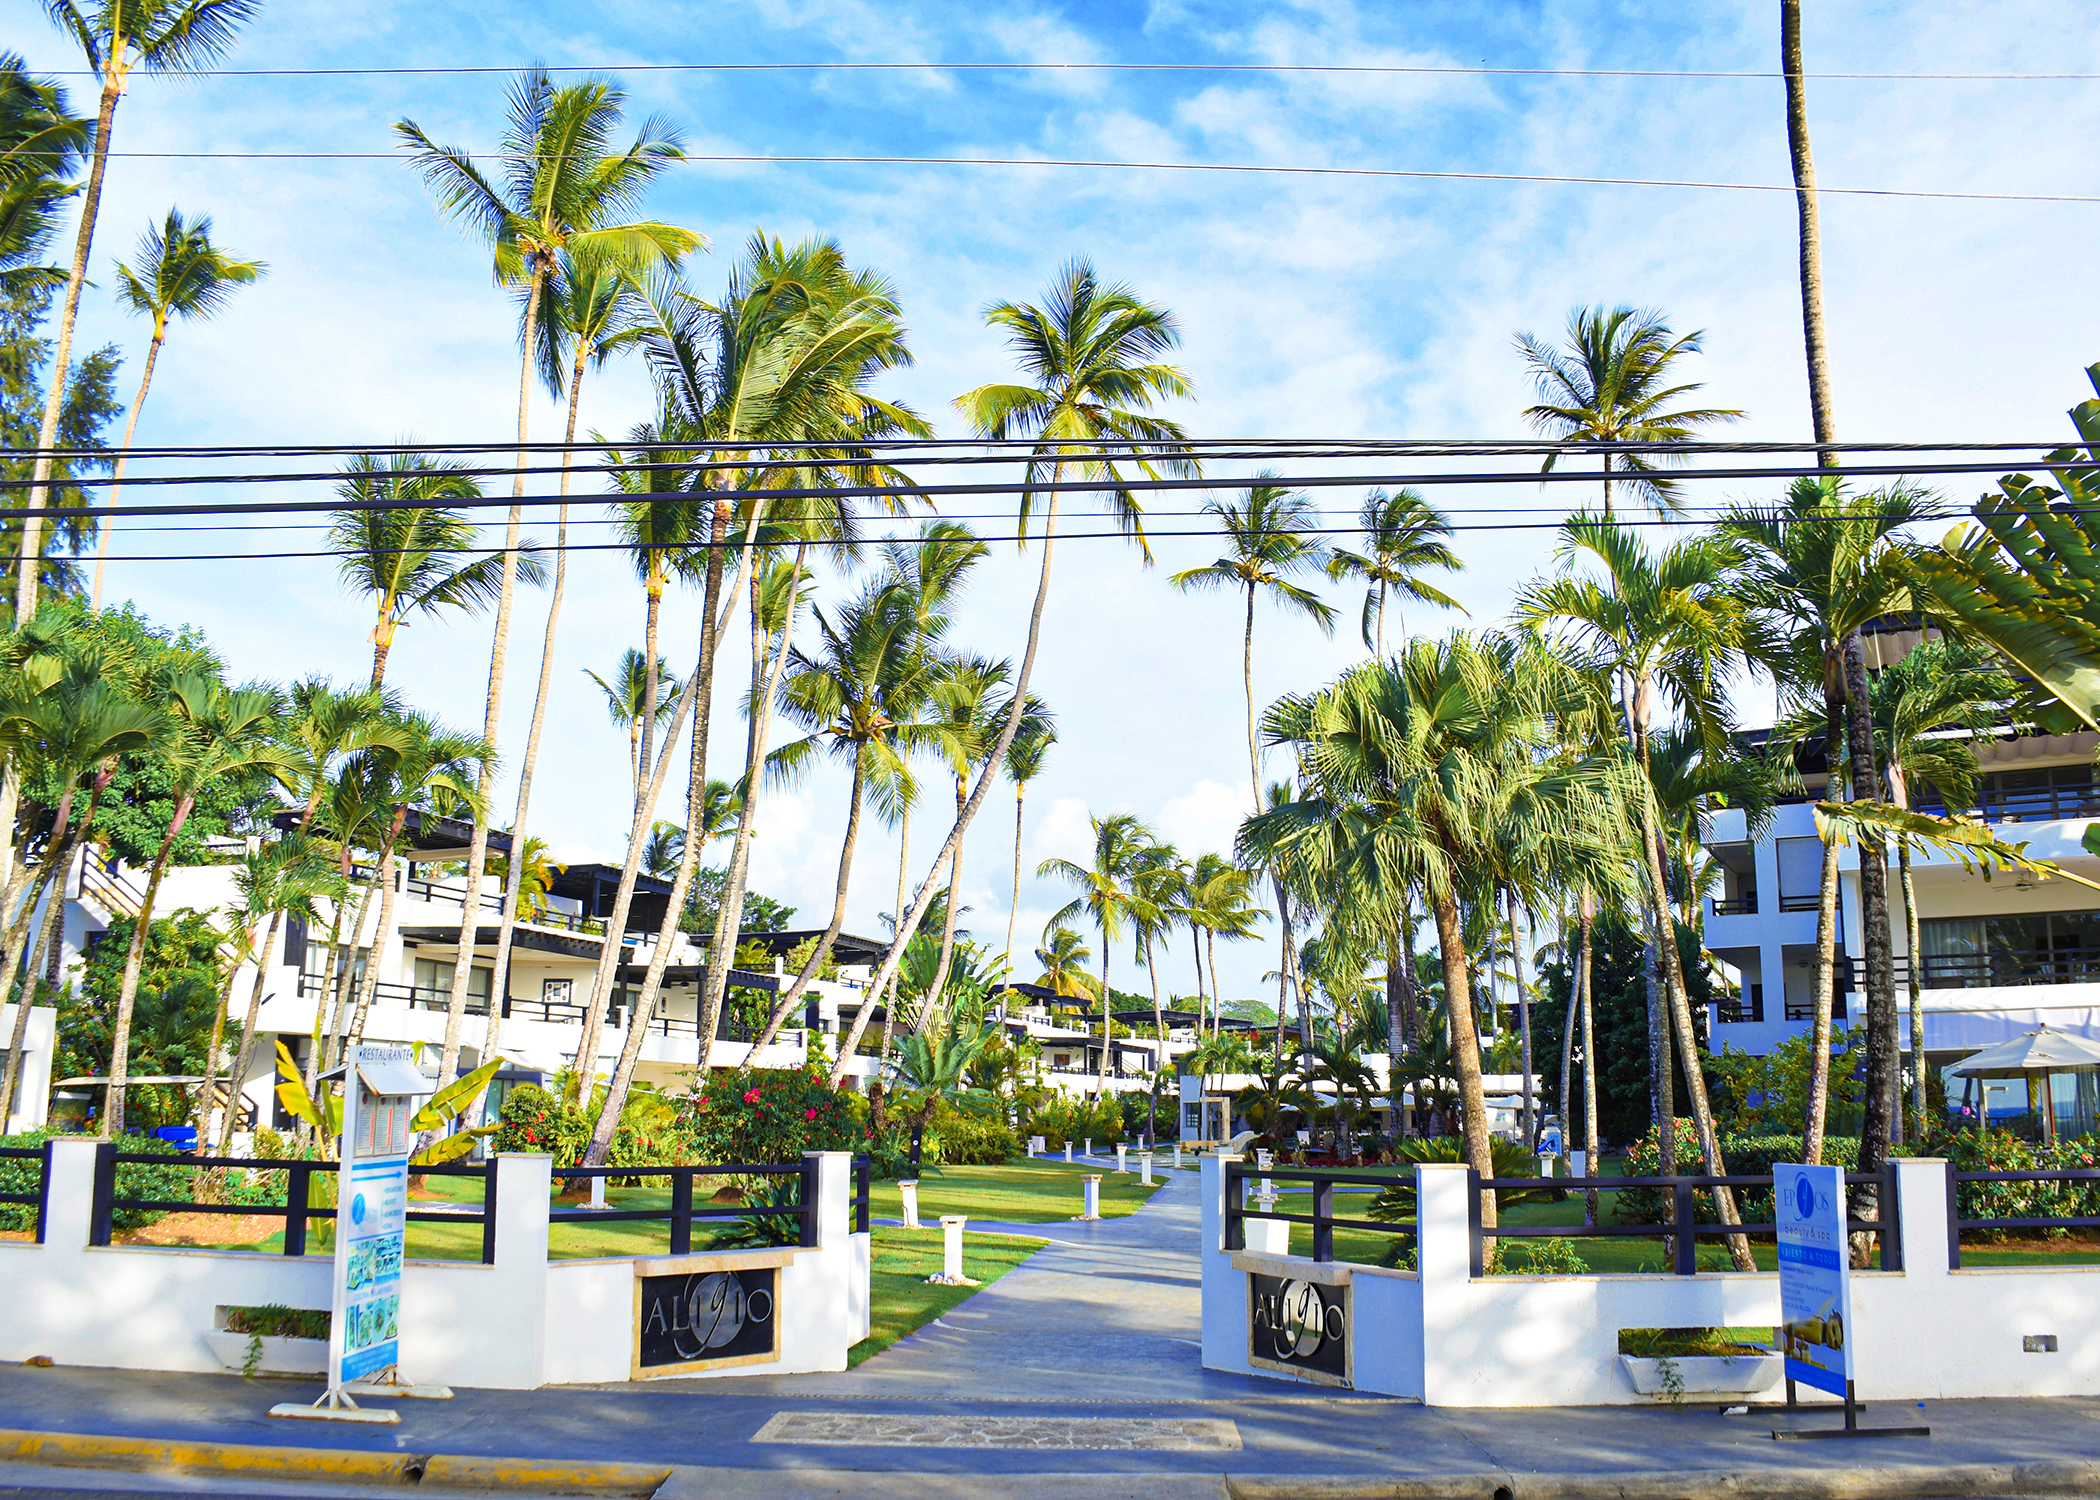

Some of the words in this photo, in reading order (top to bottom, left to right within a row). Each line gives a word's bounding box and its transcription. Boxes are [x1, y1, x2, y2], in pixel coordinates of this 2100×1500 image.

[362, 1048, 410, 1060] RESTAURANTE
[1784, 1223, 1809, 1239] beauty
[1810, 1227, 1815, 1238] &
[1817, 1231, 1831, 1241] spa
[1781, 1247, 1807, 1260] ABIERTO
[1809, 1251, 1814, 1261] A
[1815, 1252, 1836, 1265] TODOS
